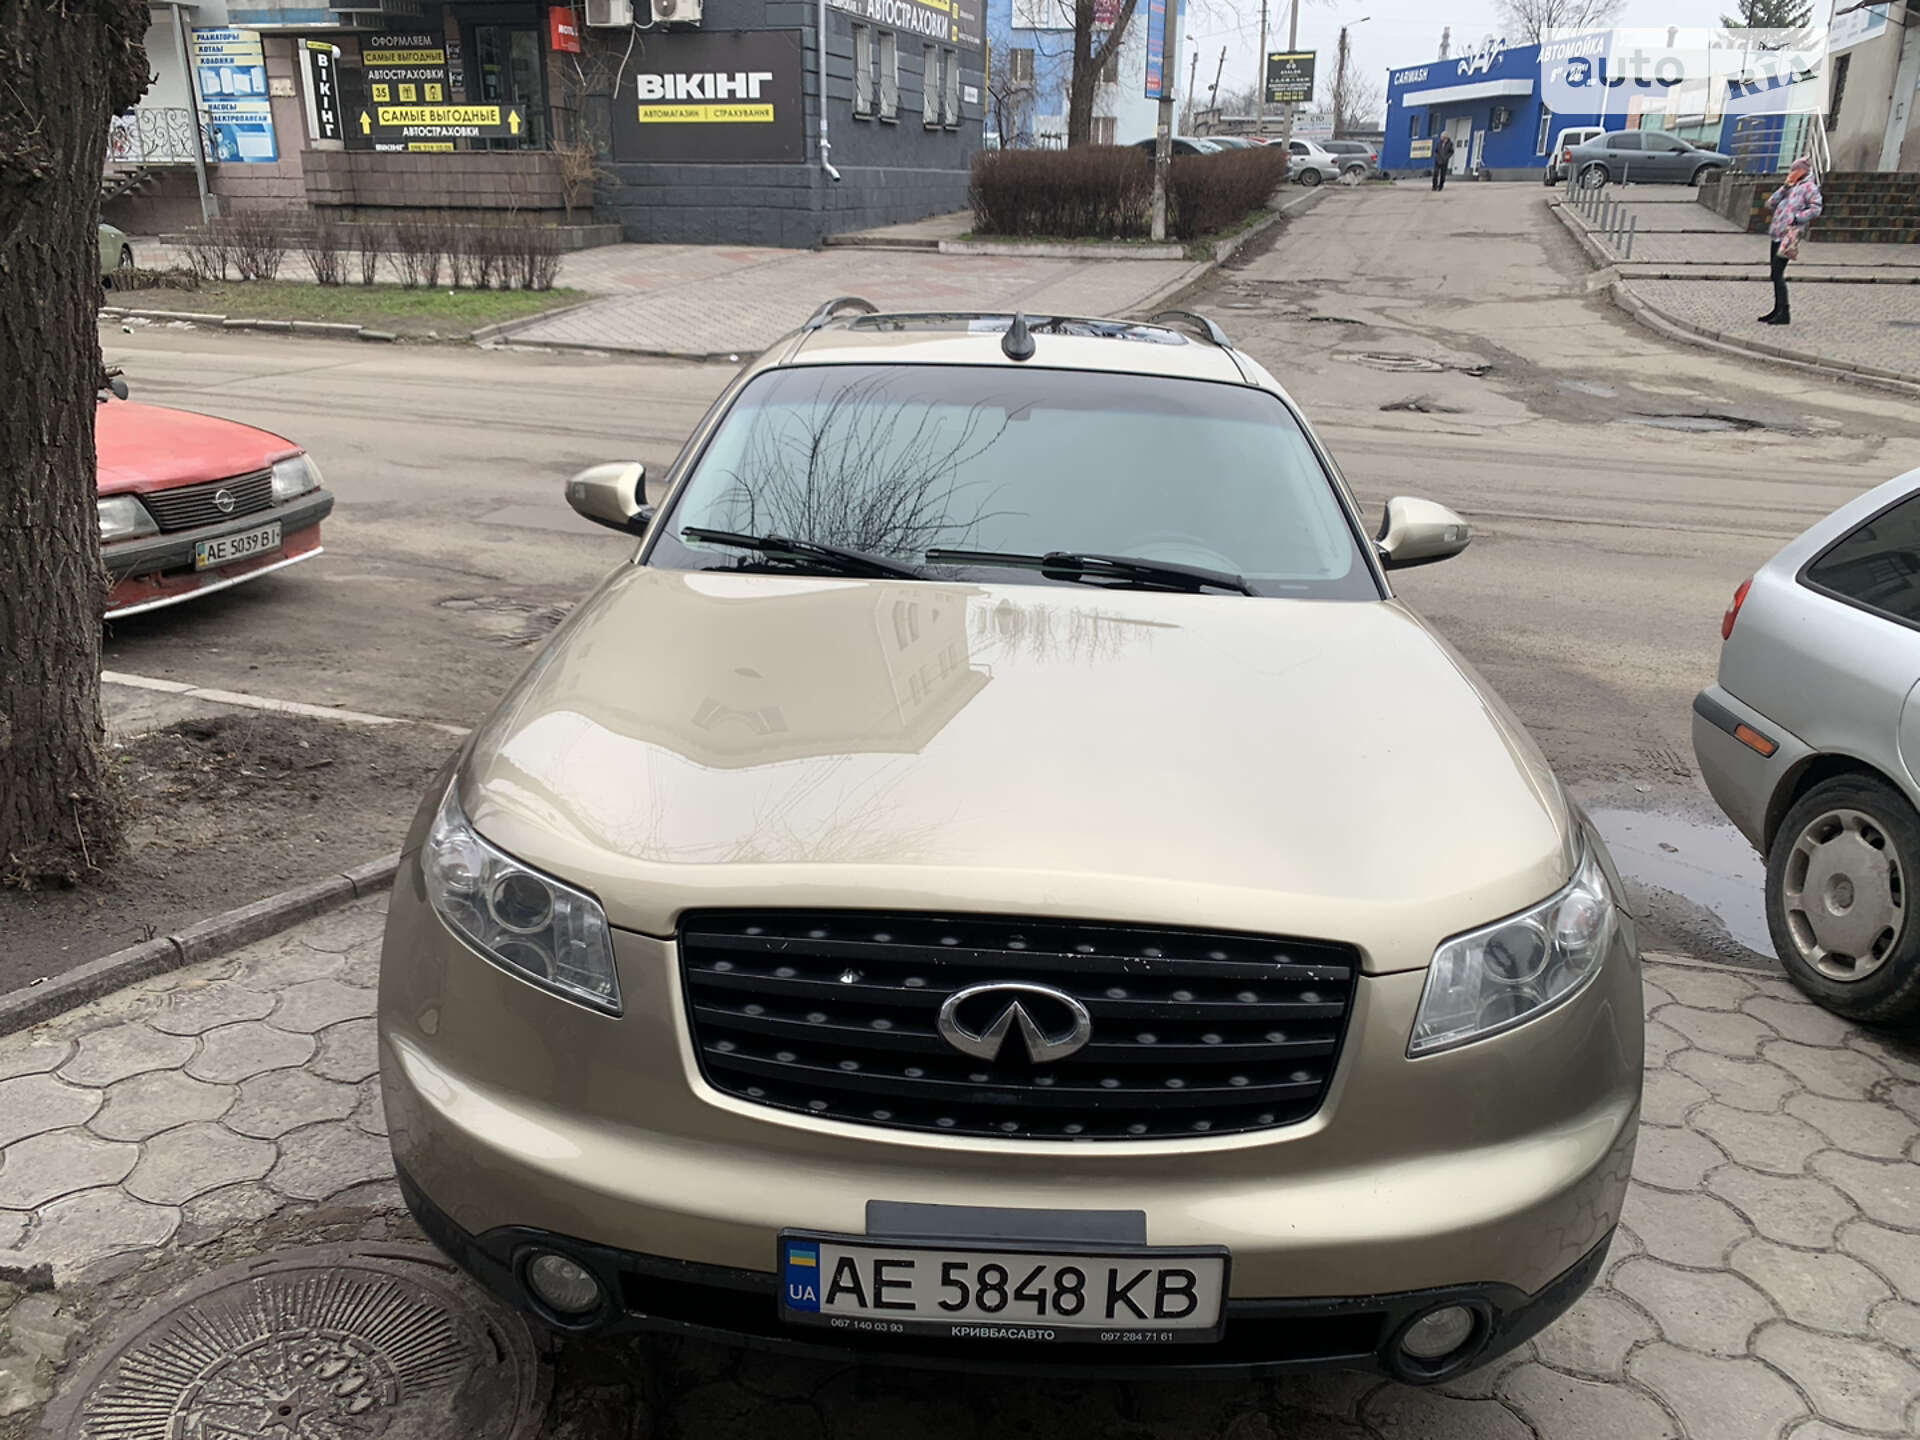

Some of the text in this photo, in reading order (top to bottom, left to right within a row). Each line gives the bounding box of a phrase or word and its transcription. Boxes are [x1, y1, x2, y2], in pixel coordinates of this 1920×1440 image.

[867, 0, 948, 39] АВТОСТРАХОВКИ
[370, 36, 432, 47] ОФОРМЛЯЕМ
[365, 52, 443, 63] САМЫЕ ВЫГОДНЫЕ
[1536, 36, 1605, 64] АВТОМОЙКА
[368, 69, 444, 80] АВТОСТРАХОВКИ
[1394, 68, 1428, 85] CARWASH
[637, 72, 773, 100] ВІКІНГ
[317, 54, 334, 136] ВІКІНГ
[211, 114, 268, 122] ЛЕКТРОПАНЕЛИ
[381, 110, 497, 123] САМЫЕ ВЫГОДНЫЕ
[643, 109, 700, 119] АВТОМАГАЗИН
[713, 109, 770, 119] СТРАХУВАННЯ
[403, 126, 479, 137] АВТОСТРАХОВКИ
[208, 542, 227, 561] AE
[231, 535, 258, 555] 5039
[789, 1284, 816, 1302] UA
[825, 1256, 1199, 1320] AE 5848 KB
[831, 1318, 904, 1333] 067 140 03 93
[951, 1326, 1056, 1341] КРИВБАСАВТО
[1101, 1331, 1174, 1342] 097 284 71 61
